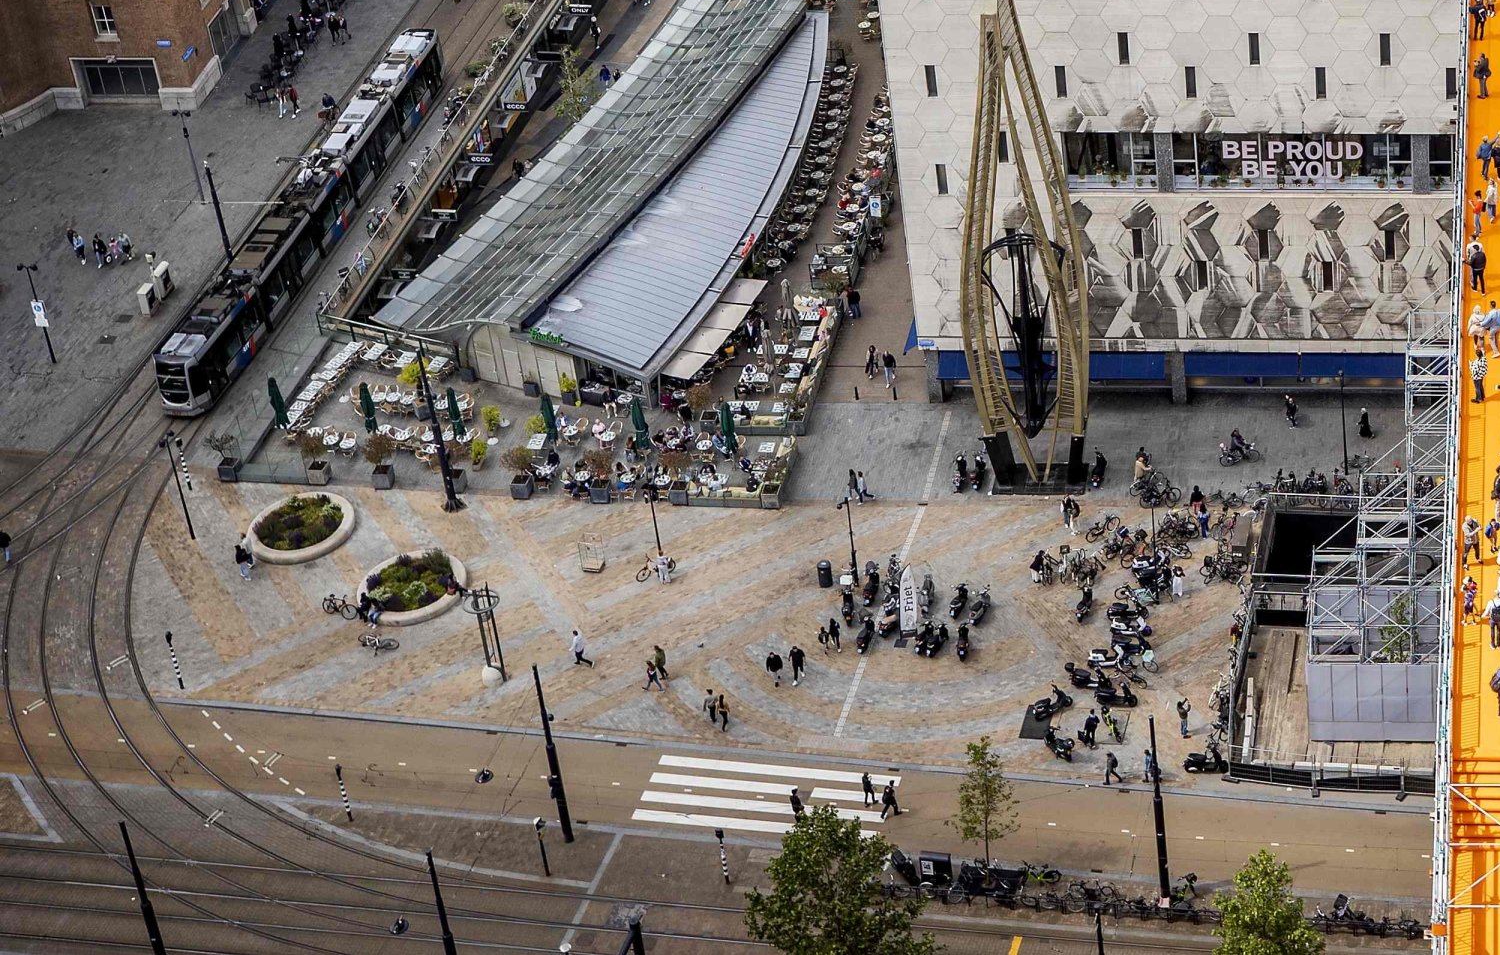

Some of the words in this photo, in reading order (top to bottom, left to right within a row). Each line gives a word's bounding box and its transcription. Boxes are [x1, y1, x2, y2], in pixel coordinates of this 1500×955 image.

[1222, 140, 1258, 160] BE
[1268, 141, 1364, 160] PROUD
[1241, 161, 1278, 180] BE
[1288, 161, 1344, 180] YOU
[903, 585, 914, 613] Friet
